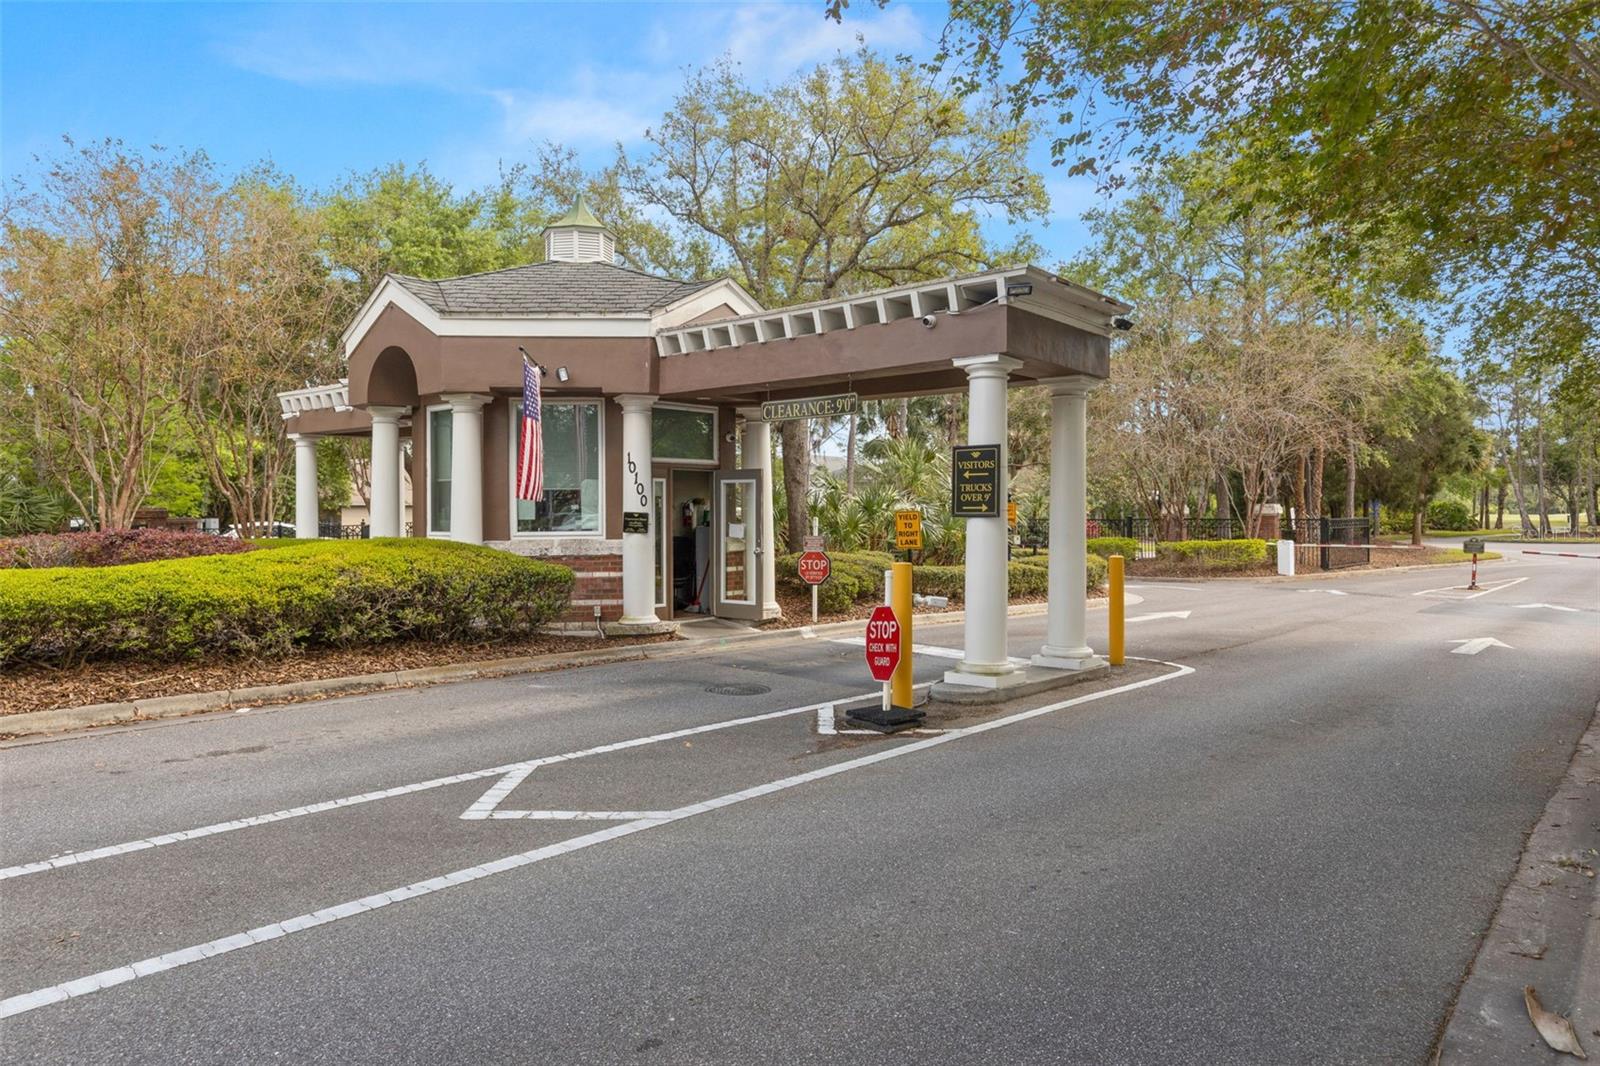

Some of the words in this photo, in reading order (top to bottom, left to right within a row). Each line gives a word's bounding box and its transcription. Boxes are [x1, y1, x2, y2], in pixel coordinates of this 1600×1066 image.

[763, 400, 834, 419] CLEARANCE:
[958, 460, 995, 469] VISITORS
[627, 452, 648, 507] 10100
[960, 483, 993, 492] TRUCKS
[960, 493, 983, 501] OVER
[800, 559, 827, 570] STOP
[869, 620, 897, 639] STOP
[869, 642, 884, 652] CHECK
[885, 643, 897, 652] WITH
[874, 656, 890, 666] GUARD
